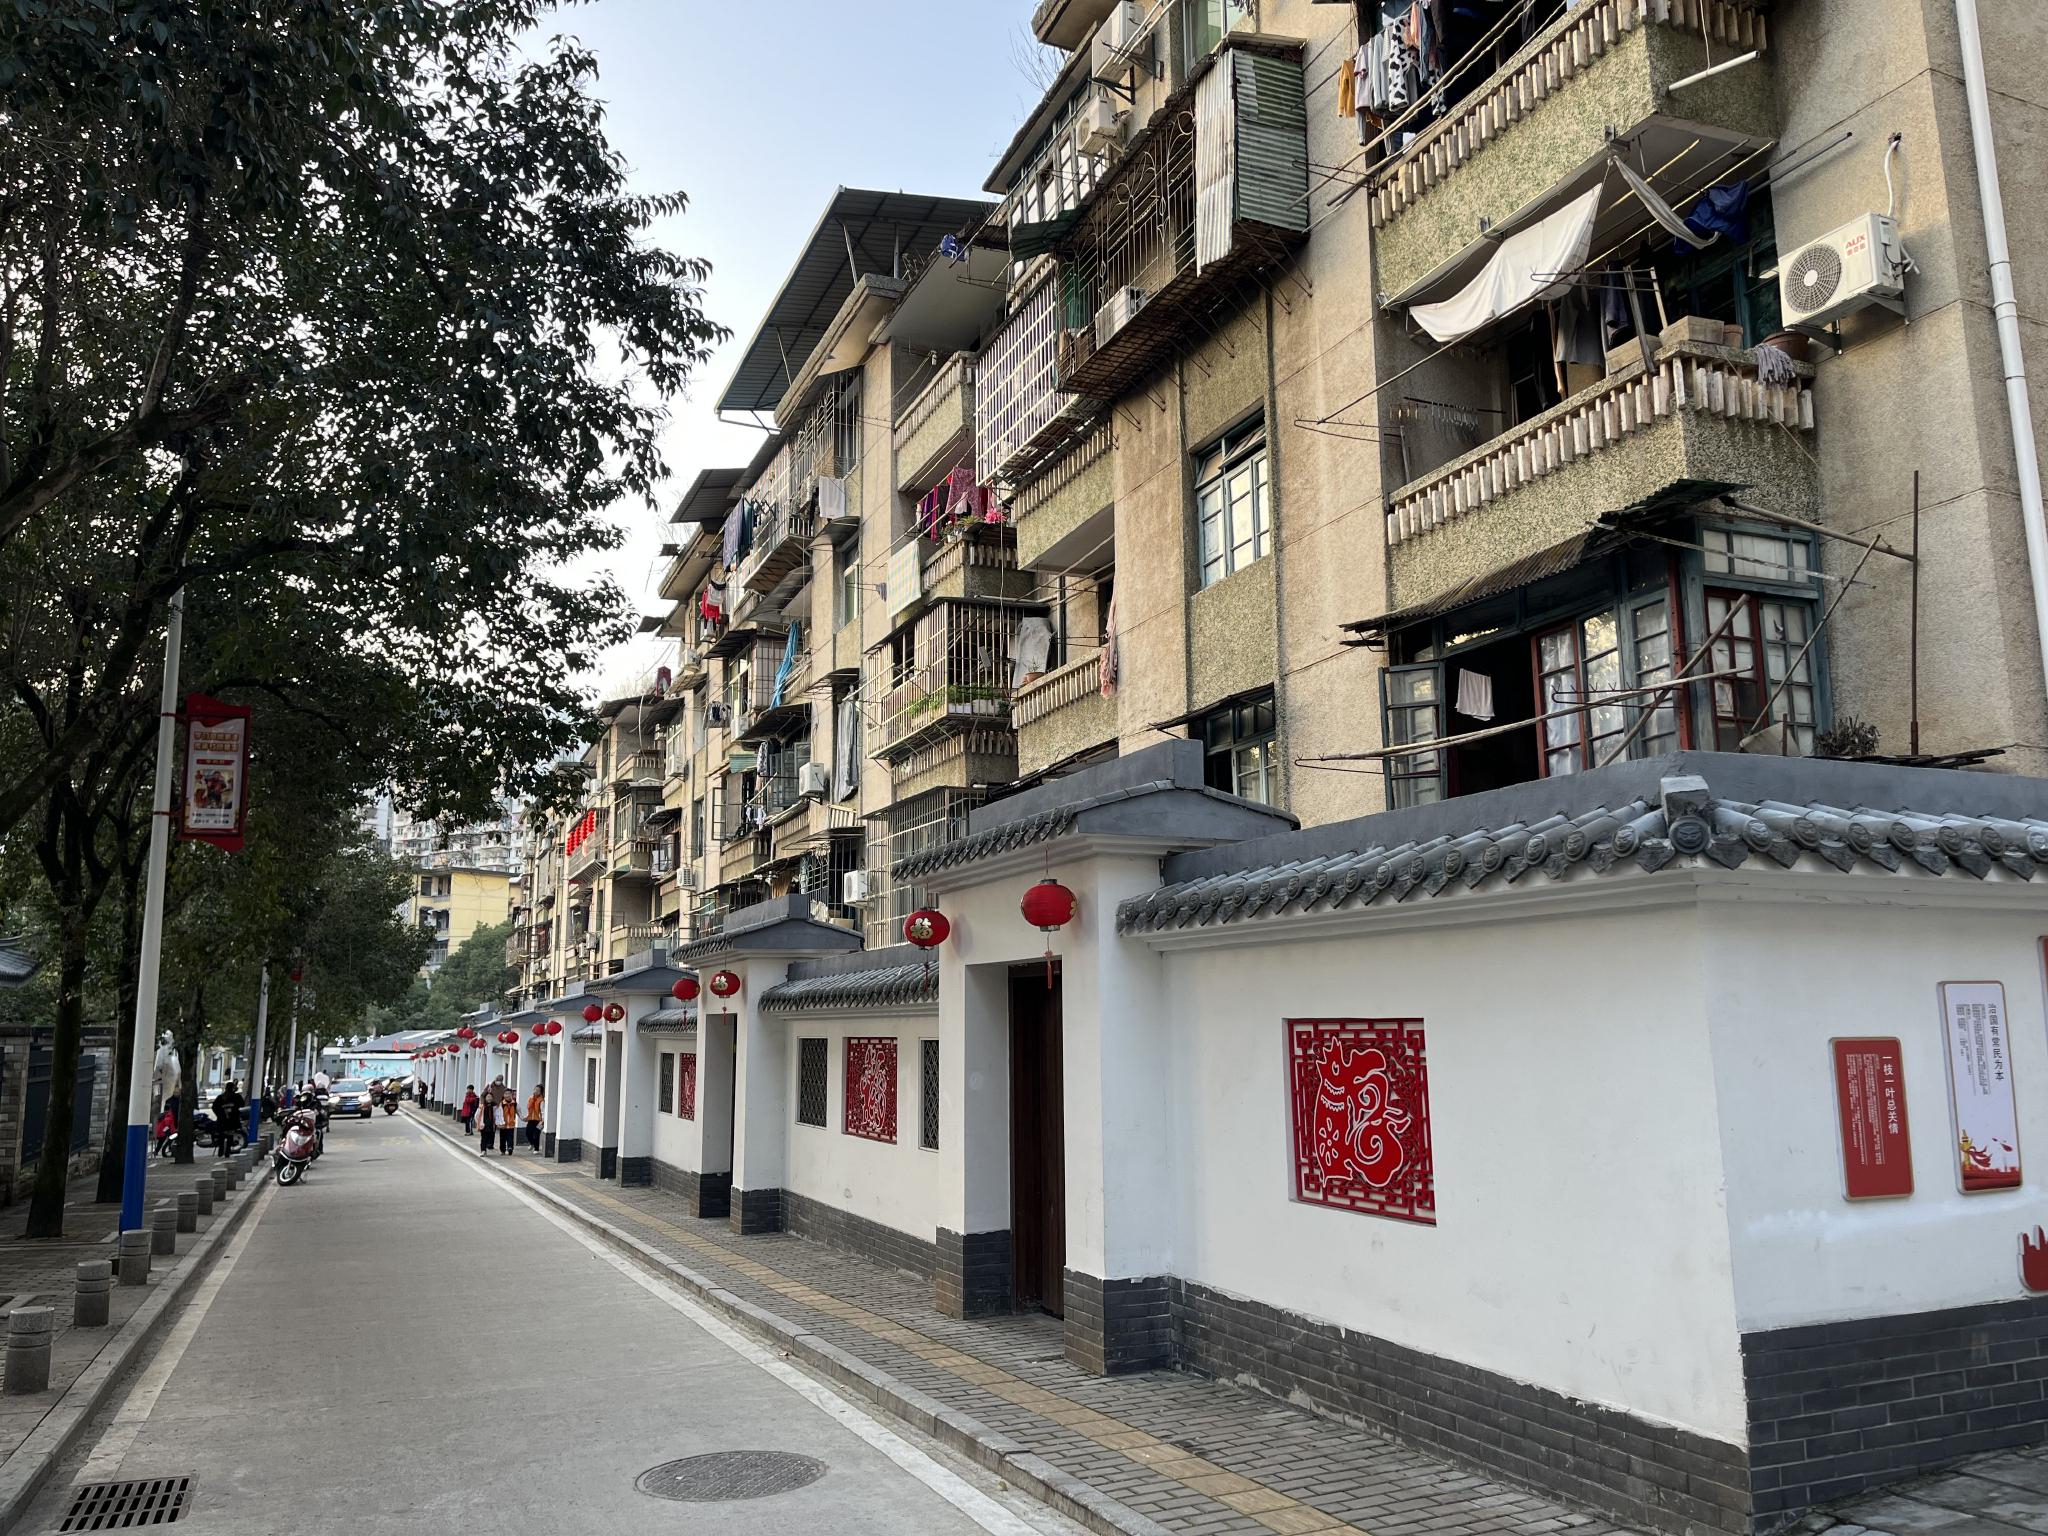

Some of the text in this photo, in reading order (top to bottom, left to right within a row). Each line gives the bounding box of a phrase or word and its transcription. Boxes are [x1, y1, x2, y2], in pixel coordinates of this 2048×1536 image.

[1988, 1003, 2005, 1082] 治国有常民为本
[1882, 1056, 1899, 1134] 一枝一叶总关情
